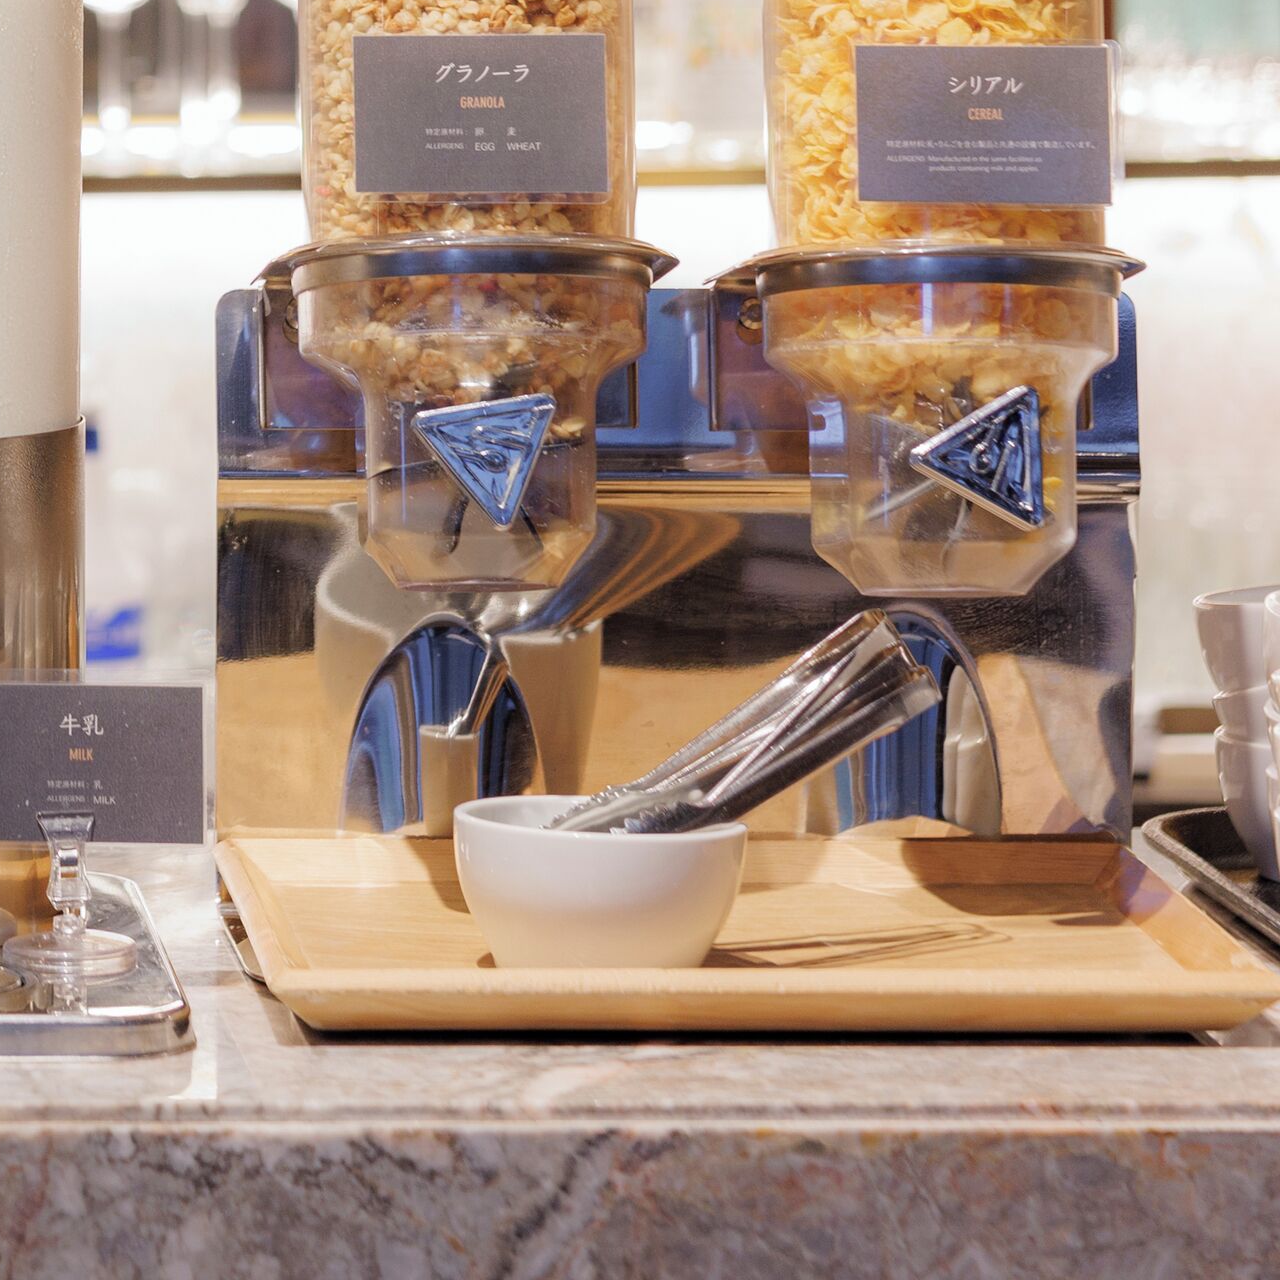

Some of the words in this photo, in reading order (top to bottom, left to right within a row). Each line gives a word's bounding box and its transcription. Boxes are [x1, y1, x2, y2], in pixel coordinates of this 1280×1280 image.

[435, 62, 529, 83] グラノーラ
[948, 75, 1024, 96] シリアル
[460, 96, 505, 109] GRANOLA
[968, 107, 1004, 120] CEREAL
[475, 142, 495, 151] EGG
[506, 142, 542, 151] WHEAT
[59, 713, 104, 737] 牛乳
[69, 748, 94, 762] MILK
[93, 795, 116, 805] MILK
